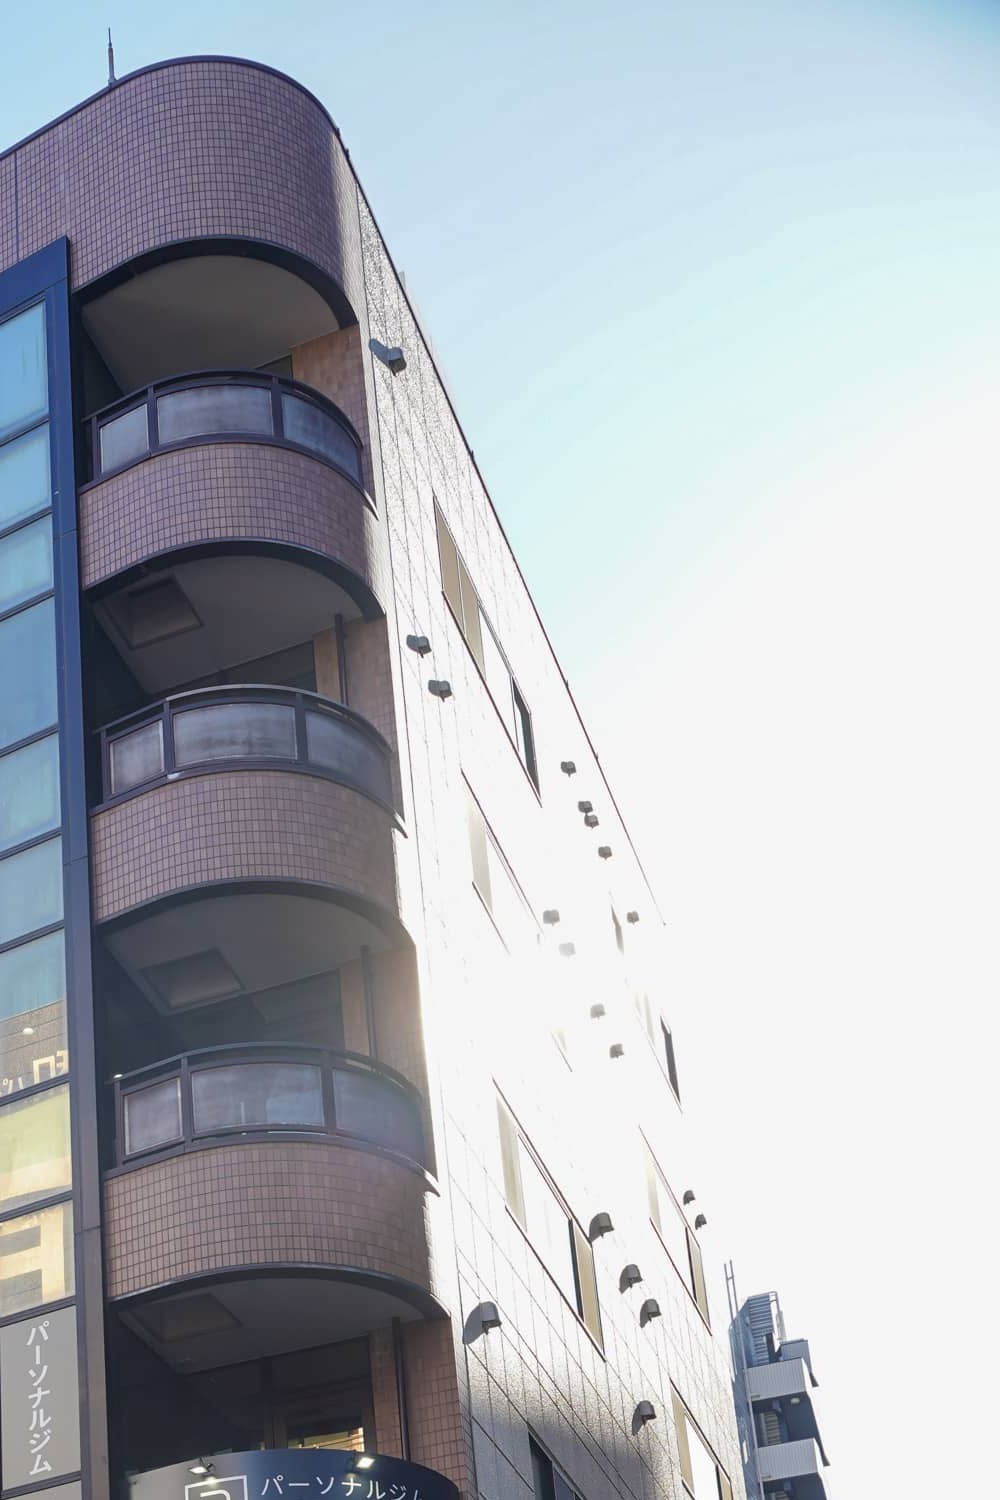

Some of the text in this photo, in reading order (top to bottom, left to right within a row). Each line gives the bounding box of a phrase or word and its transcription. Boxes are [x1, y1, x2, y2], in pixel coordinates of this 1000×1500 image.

[26, 1320, 53, 1476] パーソナルジム
